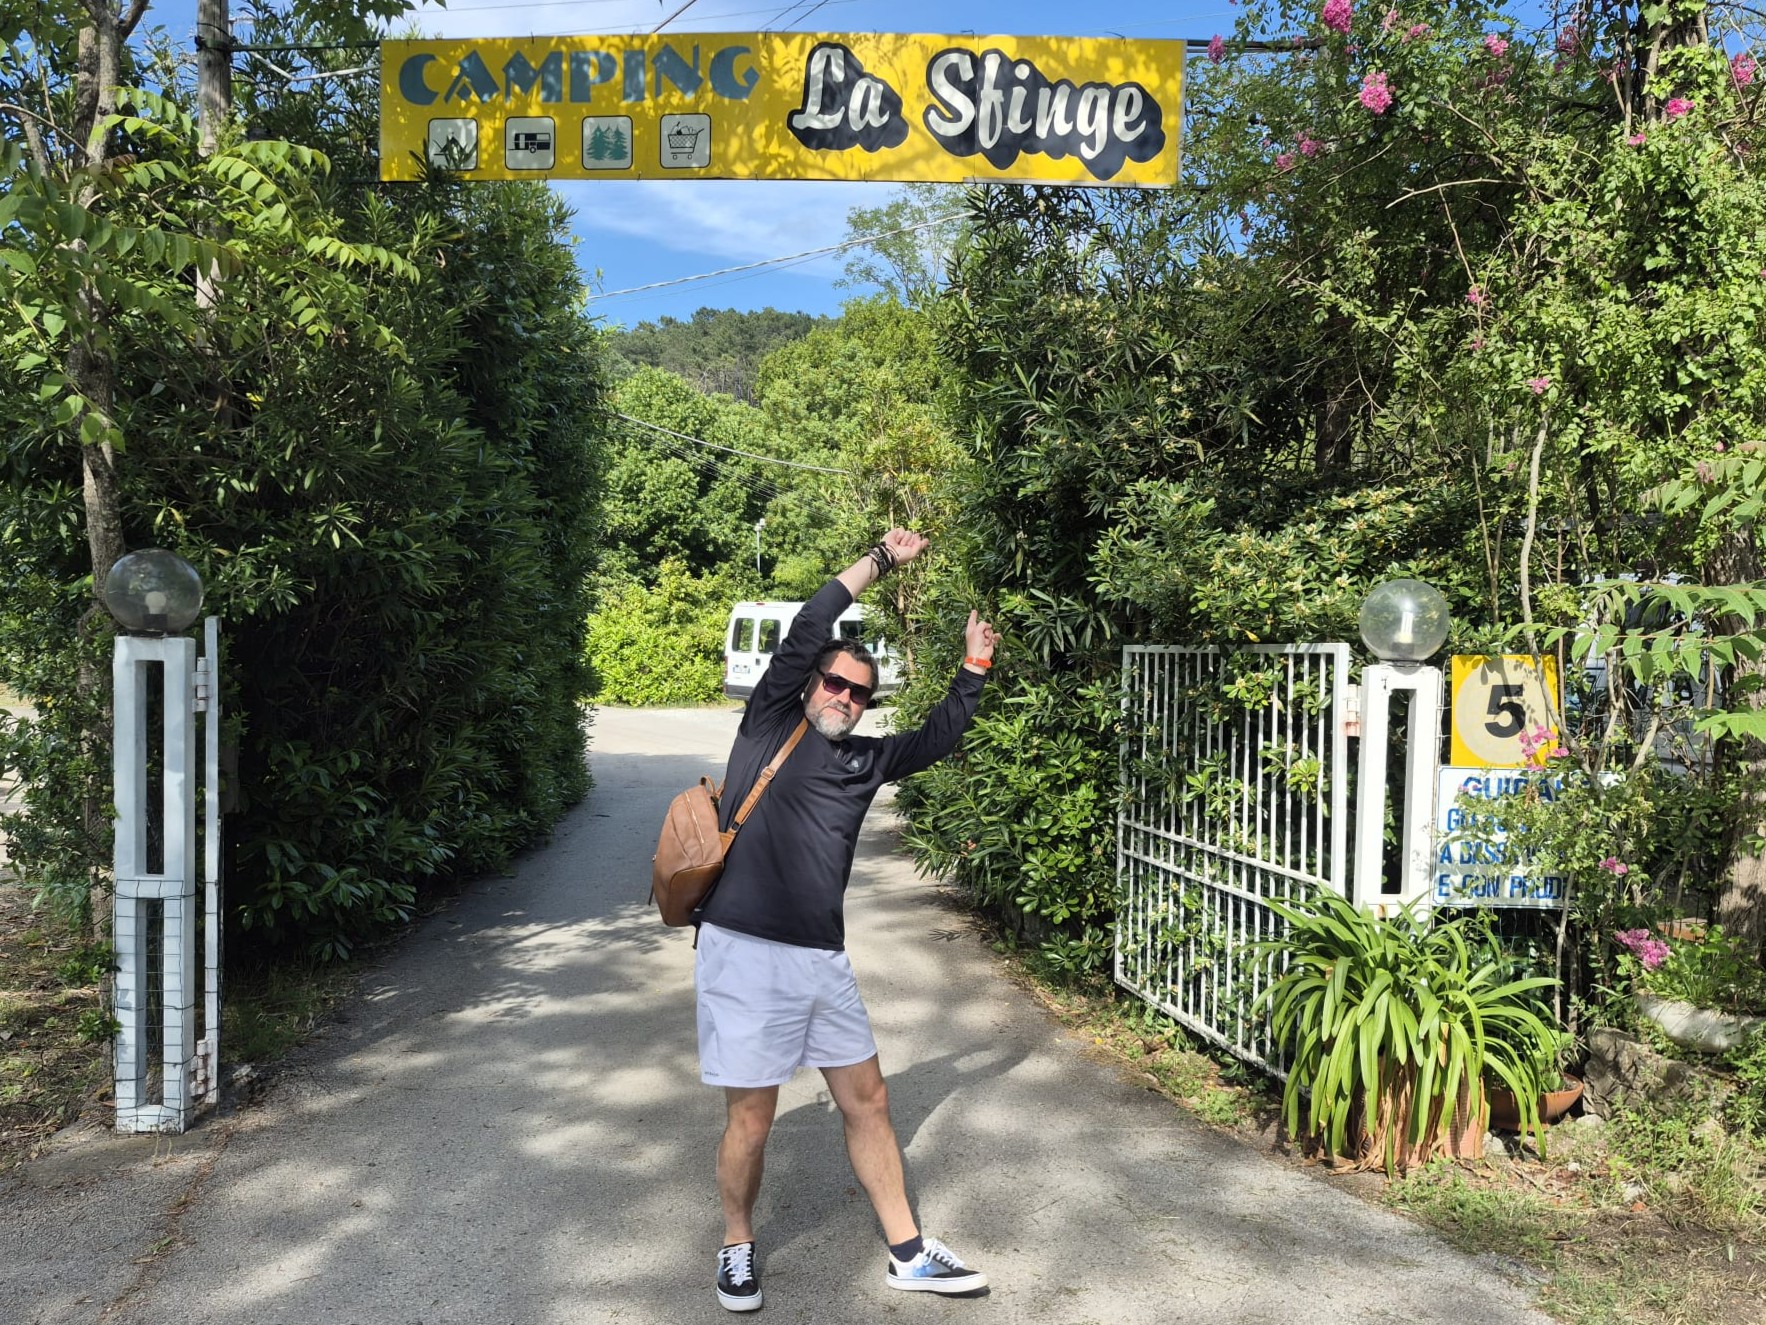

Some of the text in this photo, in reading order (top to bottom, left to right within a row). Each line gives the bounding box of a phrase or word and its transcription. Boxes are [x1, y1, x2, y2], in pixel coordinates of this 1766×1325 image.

[399, 43, 1150, 162] CAMPING La Sfinge
[1484, 684, 1526, 738] 5
[1461, 776, 1590, 801] GUIDA
[1440, 842, 1453, 864] A
[1438, 874, 1450, 897] E
